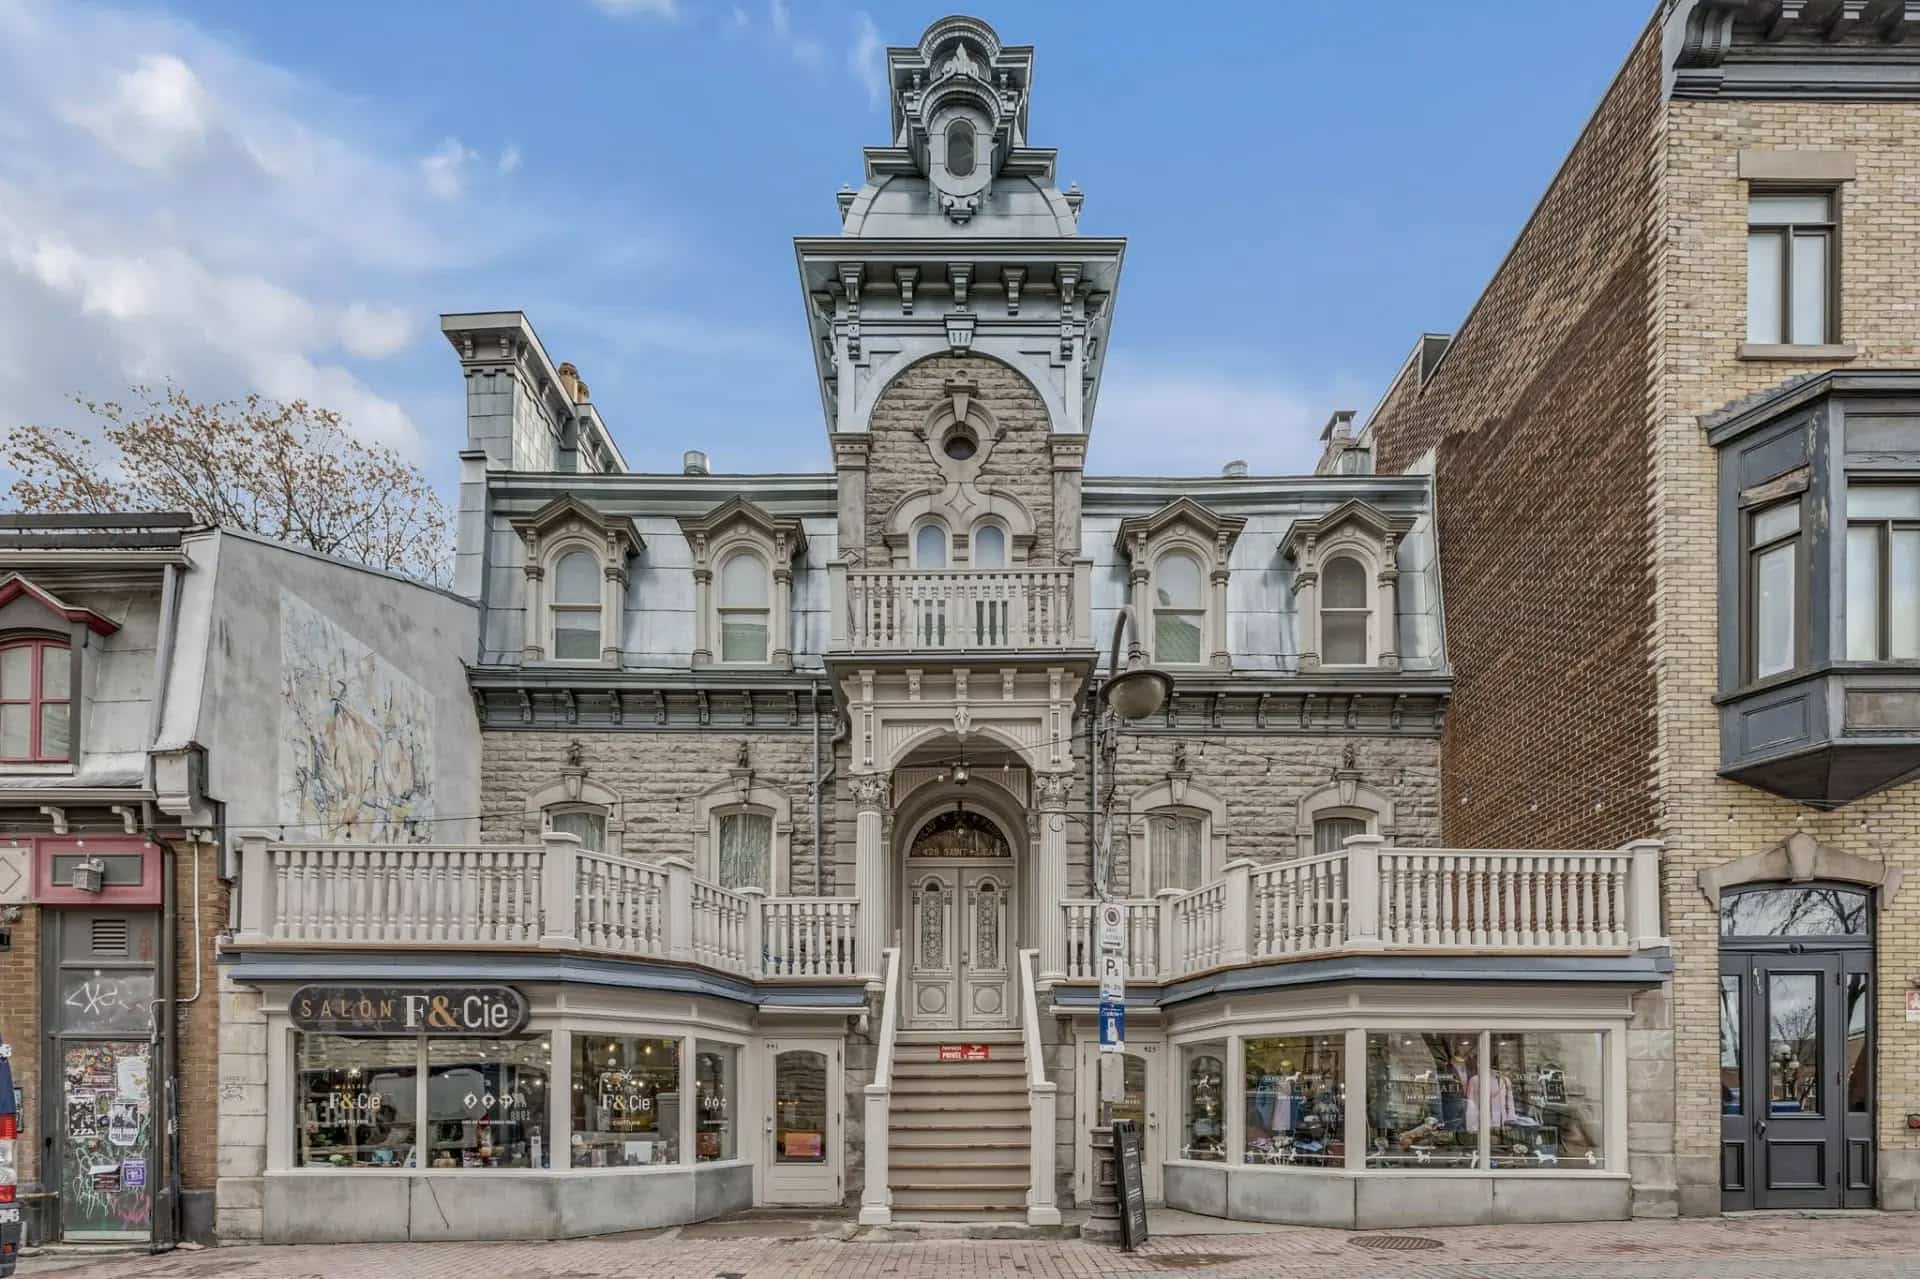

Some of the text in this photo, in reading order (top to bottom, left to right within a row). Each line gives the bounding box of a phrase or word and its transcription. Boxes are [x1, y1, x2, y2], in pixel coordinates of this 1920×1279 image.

[301, 994, 509, 1029] SALON F&Cie
[602, 1093, 651, 1111] F&Cie
